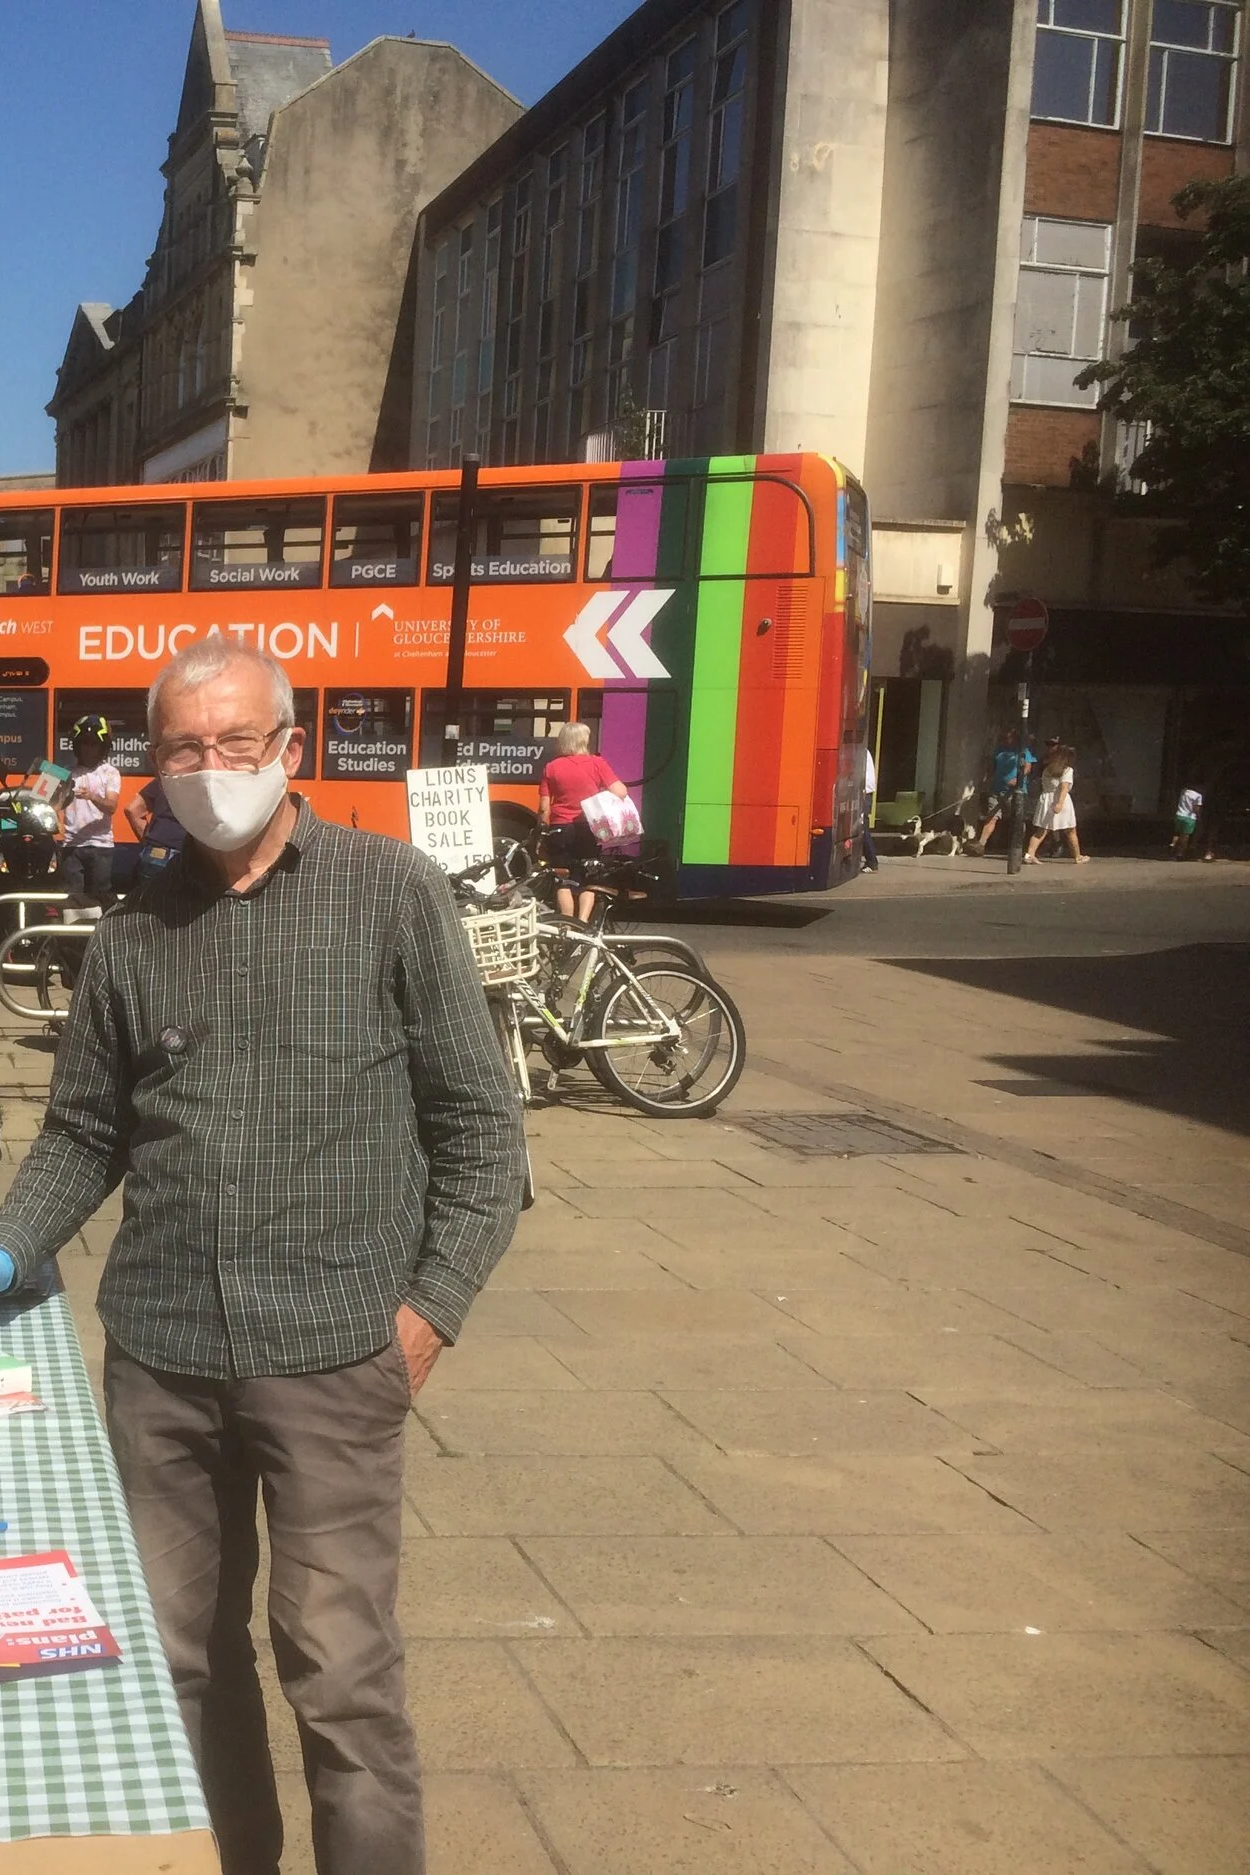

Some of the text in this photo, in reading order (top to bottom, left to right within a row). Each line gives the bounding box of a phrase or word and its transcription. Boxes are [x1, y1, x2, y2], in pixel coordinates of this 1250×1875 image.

[210, 566, 300, 583] Social Work
[351, 564, 397, 579] PGCE
[432, 559, 572, 578] Spts Education
[79, 571, 160, 587] Youth Work
[21, 620, 53, 634] WEST
[482, 619, 501, 630] OF
[393, 632, 526, 645] GLOUCEERSHIRE
[402, 650, 443, 658] Cheltenham
[328, 741, 407, 755] Education
[479, 742, 544, 759] Primary
[337, 757, 396, 772] Studies
[425, 768, 477, 786] LIONS
[410, 786, 485, 807] CHARITY
[425, 810, 471, 828] BOOK
[427, 830, 473, 848] SALE
[49, 1606, 83, 1615] for
[42, 1615, 88, 1627] Bad
[6, 1630, 98, 1646] plans:
[40, 1643, 102, 1660] NHS
